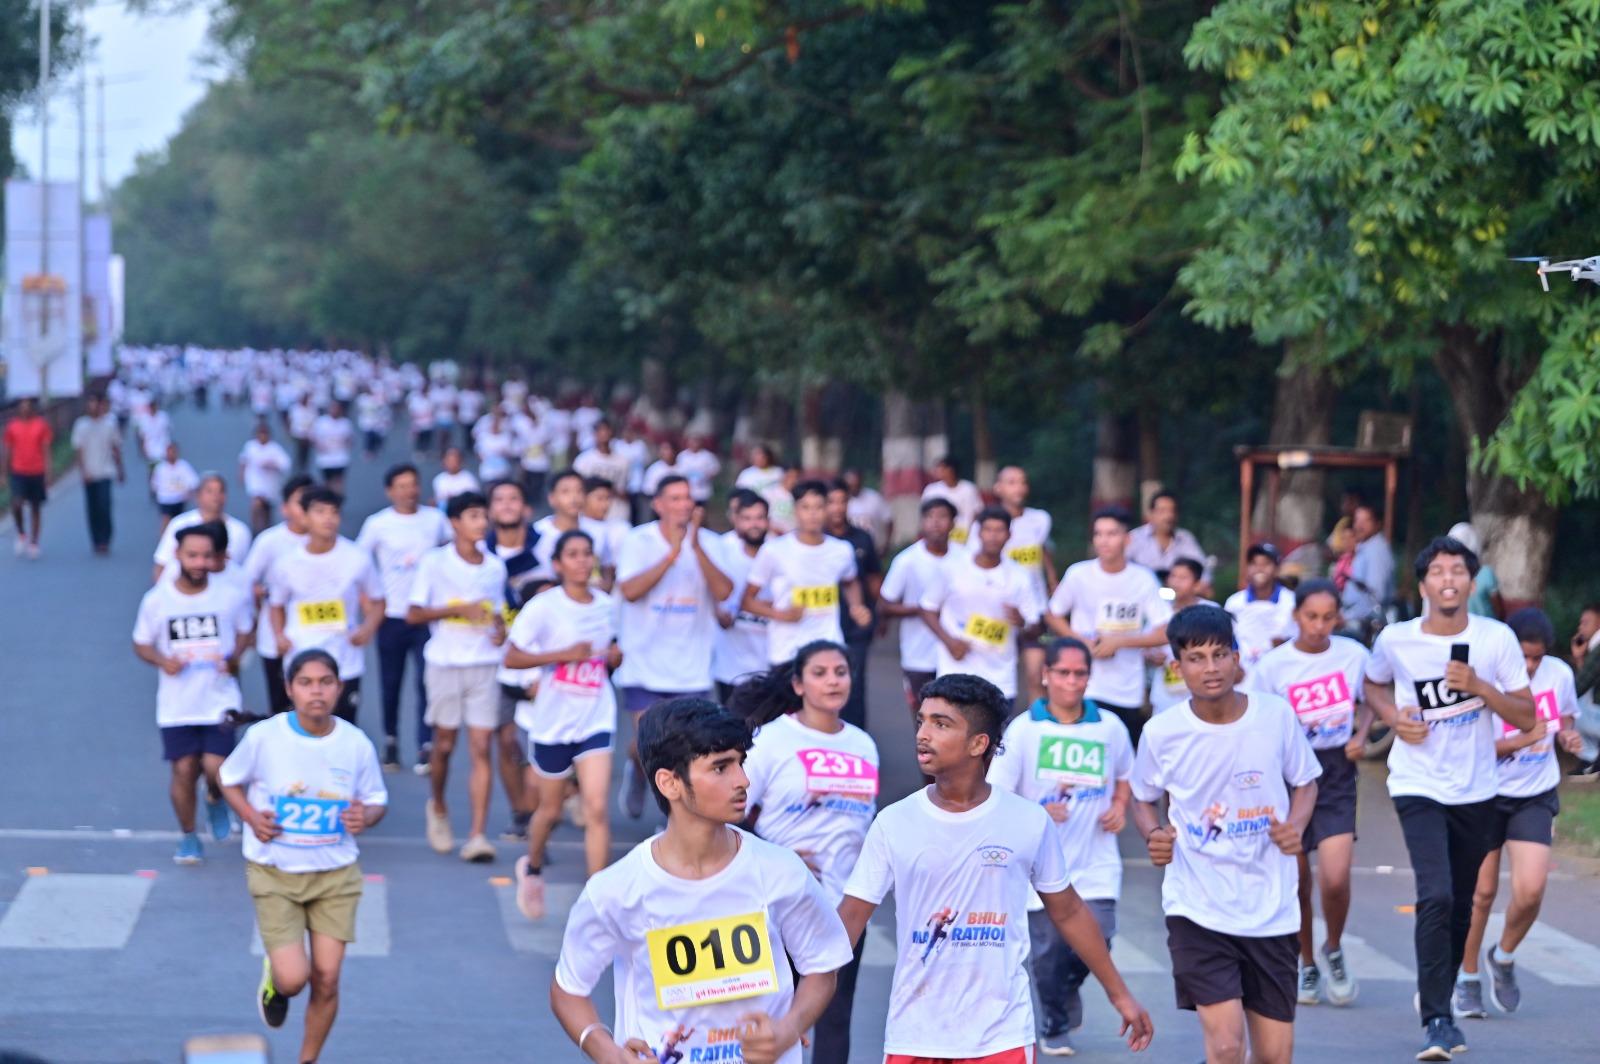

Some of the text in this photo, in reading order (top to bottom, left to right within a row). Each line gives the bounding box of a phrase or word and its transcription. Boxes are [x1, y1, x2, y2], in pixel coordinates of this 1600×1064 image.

[1293, 677, 1341, 711] 231
[806, 751, 863, 775] 231
[1048, 741, 1101, 772] 104
[282, 802, 339, 830] 221
[666, 924, 761, 976] 010
